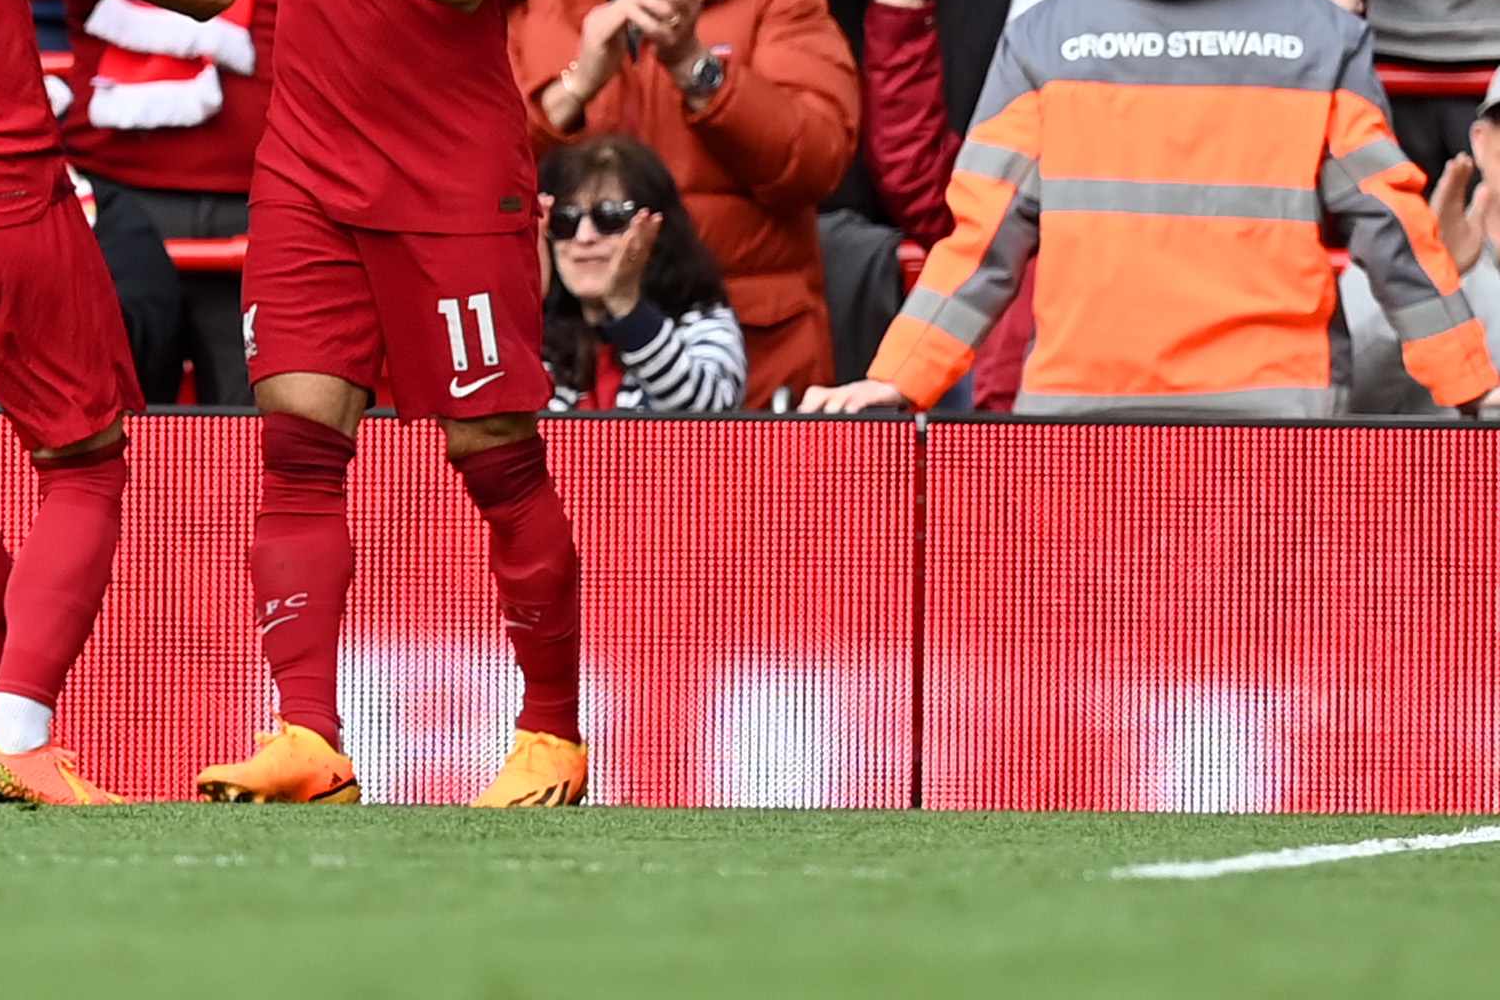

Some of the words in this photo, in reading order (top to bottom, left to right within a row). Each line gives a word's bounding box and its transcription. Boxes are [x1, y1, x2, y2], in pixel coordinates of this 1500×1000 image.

[1060, 31, 1164, 60] CROWD
[1167, 30, 1304, 59] STEWARD
[437, 291, 499, 372] 11
